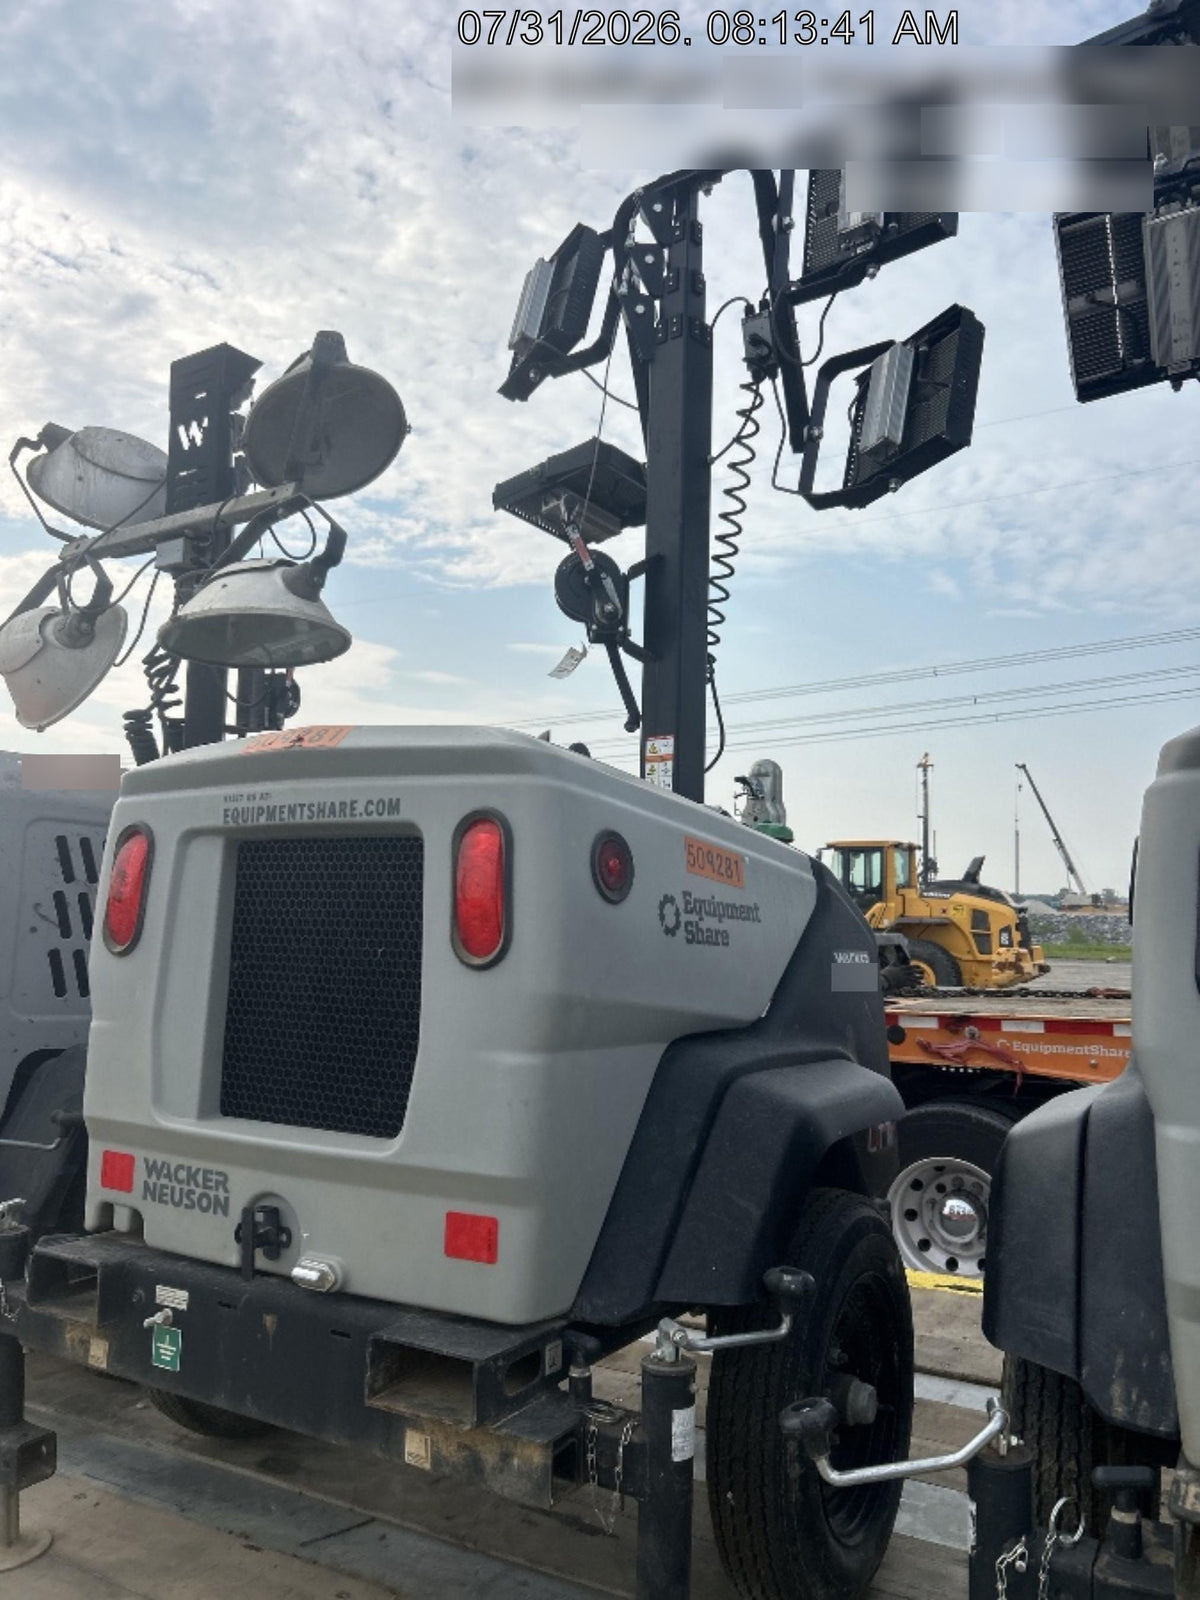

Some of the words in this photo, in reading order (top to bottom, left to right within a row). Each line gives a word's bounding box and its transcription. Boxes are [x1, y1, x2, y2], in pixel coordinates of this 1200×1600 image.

[223, 797, 401, 825] EQUIPMENTSHARE.COM
[686, 842, 743, 883] 509281
[682, 890, 762, 923] Equipment
[684, 919, 730, 946] Share
[143, 1156, 231, 1194] WACKER
[142, 1180, 231, 1218] NEUSON
